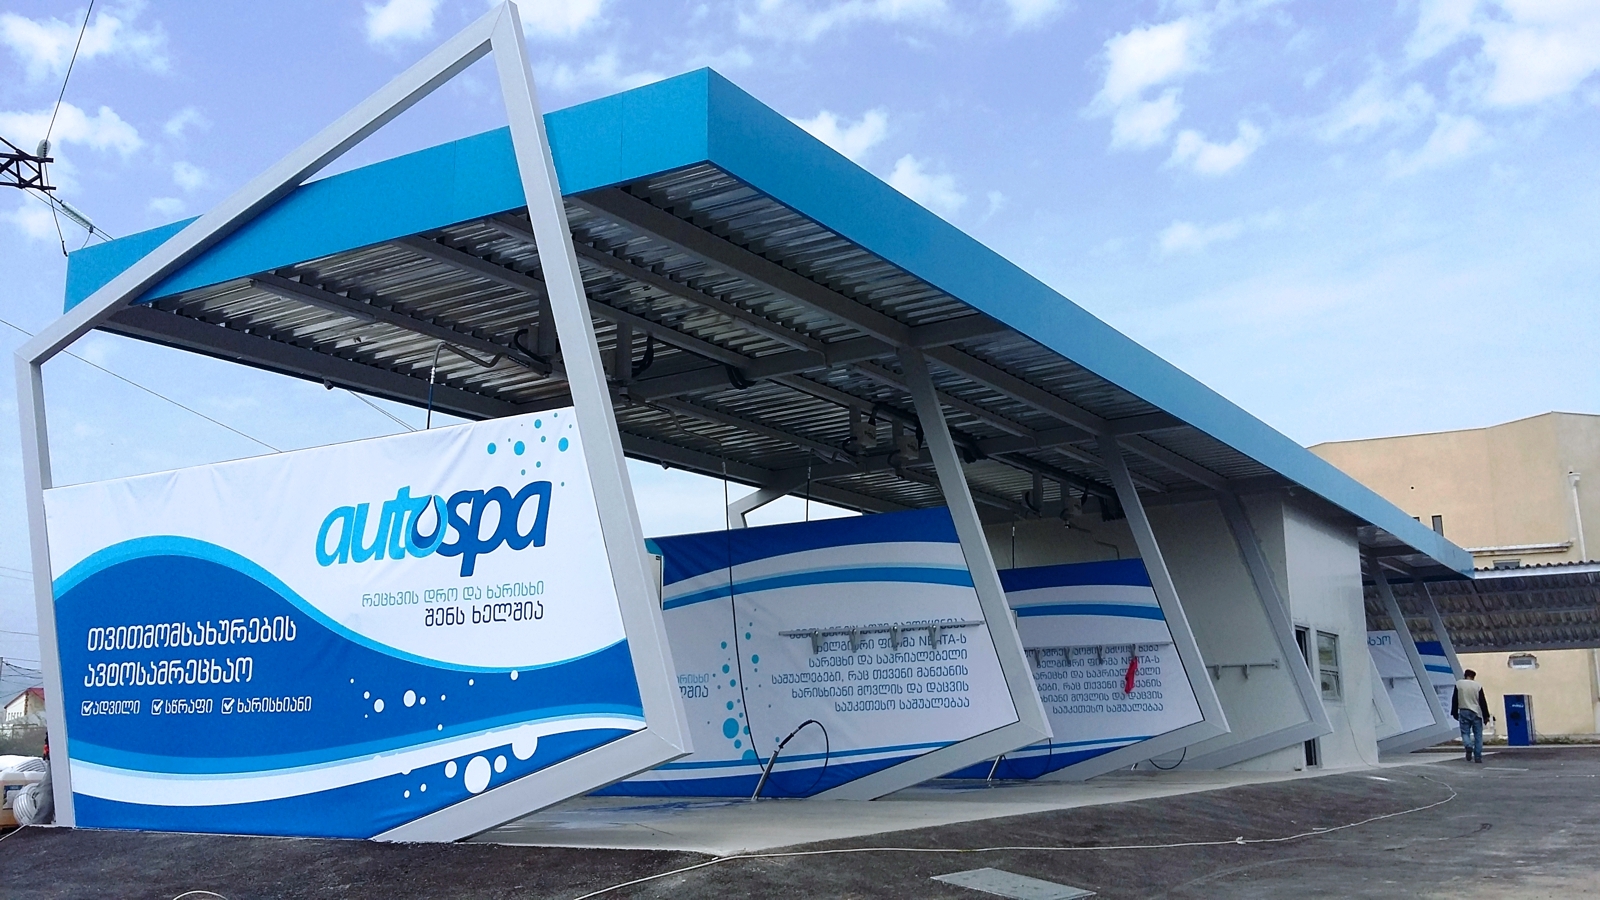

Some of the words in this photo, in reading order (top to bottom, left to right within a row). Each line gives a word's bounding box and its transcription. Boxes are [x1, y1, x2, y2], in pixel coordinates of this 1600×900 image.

[315, 480, 553, 578] autospa
[361, 590, 419, 608] რეცხვის
[423, 586, 458, 603] დრო
[462, 585, 482, 601] და
[486, 580, 544, 599] ხარისხი
[424, 605, 465, 627] შენს
[471, 601, 544, 625] ხელშია
[87, 615, 297, 652] თვითმომსახურების
[816, 638, 875, 653] ელგირი
[877, 636, 915, 649] ფიმა
[808, 655, 854, 668] სარეცხი
[857, 654, 873, 665] და
[876, 648, 968, 665] საპრიალებელი
[84, 656, 254, 688] ავტოსამრეცხაო
[676, 673, 710, 684] რისხი
[847, 670, 869, 681] რაც
[872, 667, 913, 680] თქვენი
[916, 664, 969, 678] მანქანის
[1070, 670, 1084, 679] და
[1086, 666, 1161, 678] საპრიალბელი
[791, 685, 854, 699] ხარისხიანი
[857, 683, 903, 696] მოვლის
[906, 682, 923, 694] და
[926, 680, 969, 693] დაცვის
[1120, 678, 1162, 689] მქანის
[92, 699, 141, 716] ადვილი
[164, 698, 213, 715] სწრაფი
[236, 695, 312, 714] ხარისხიანი
[834, 699, 896, 712] საუკეთესო
[899, 696, 970, 710] საშუალებაა
